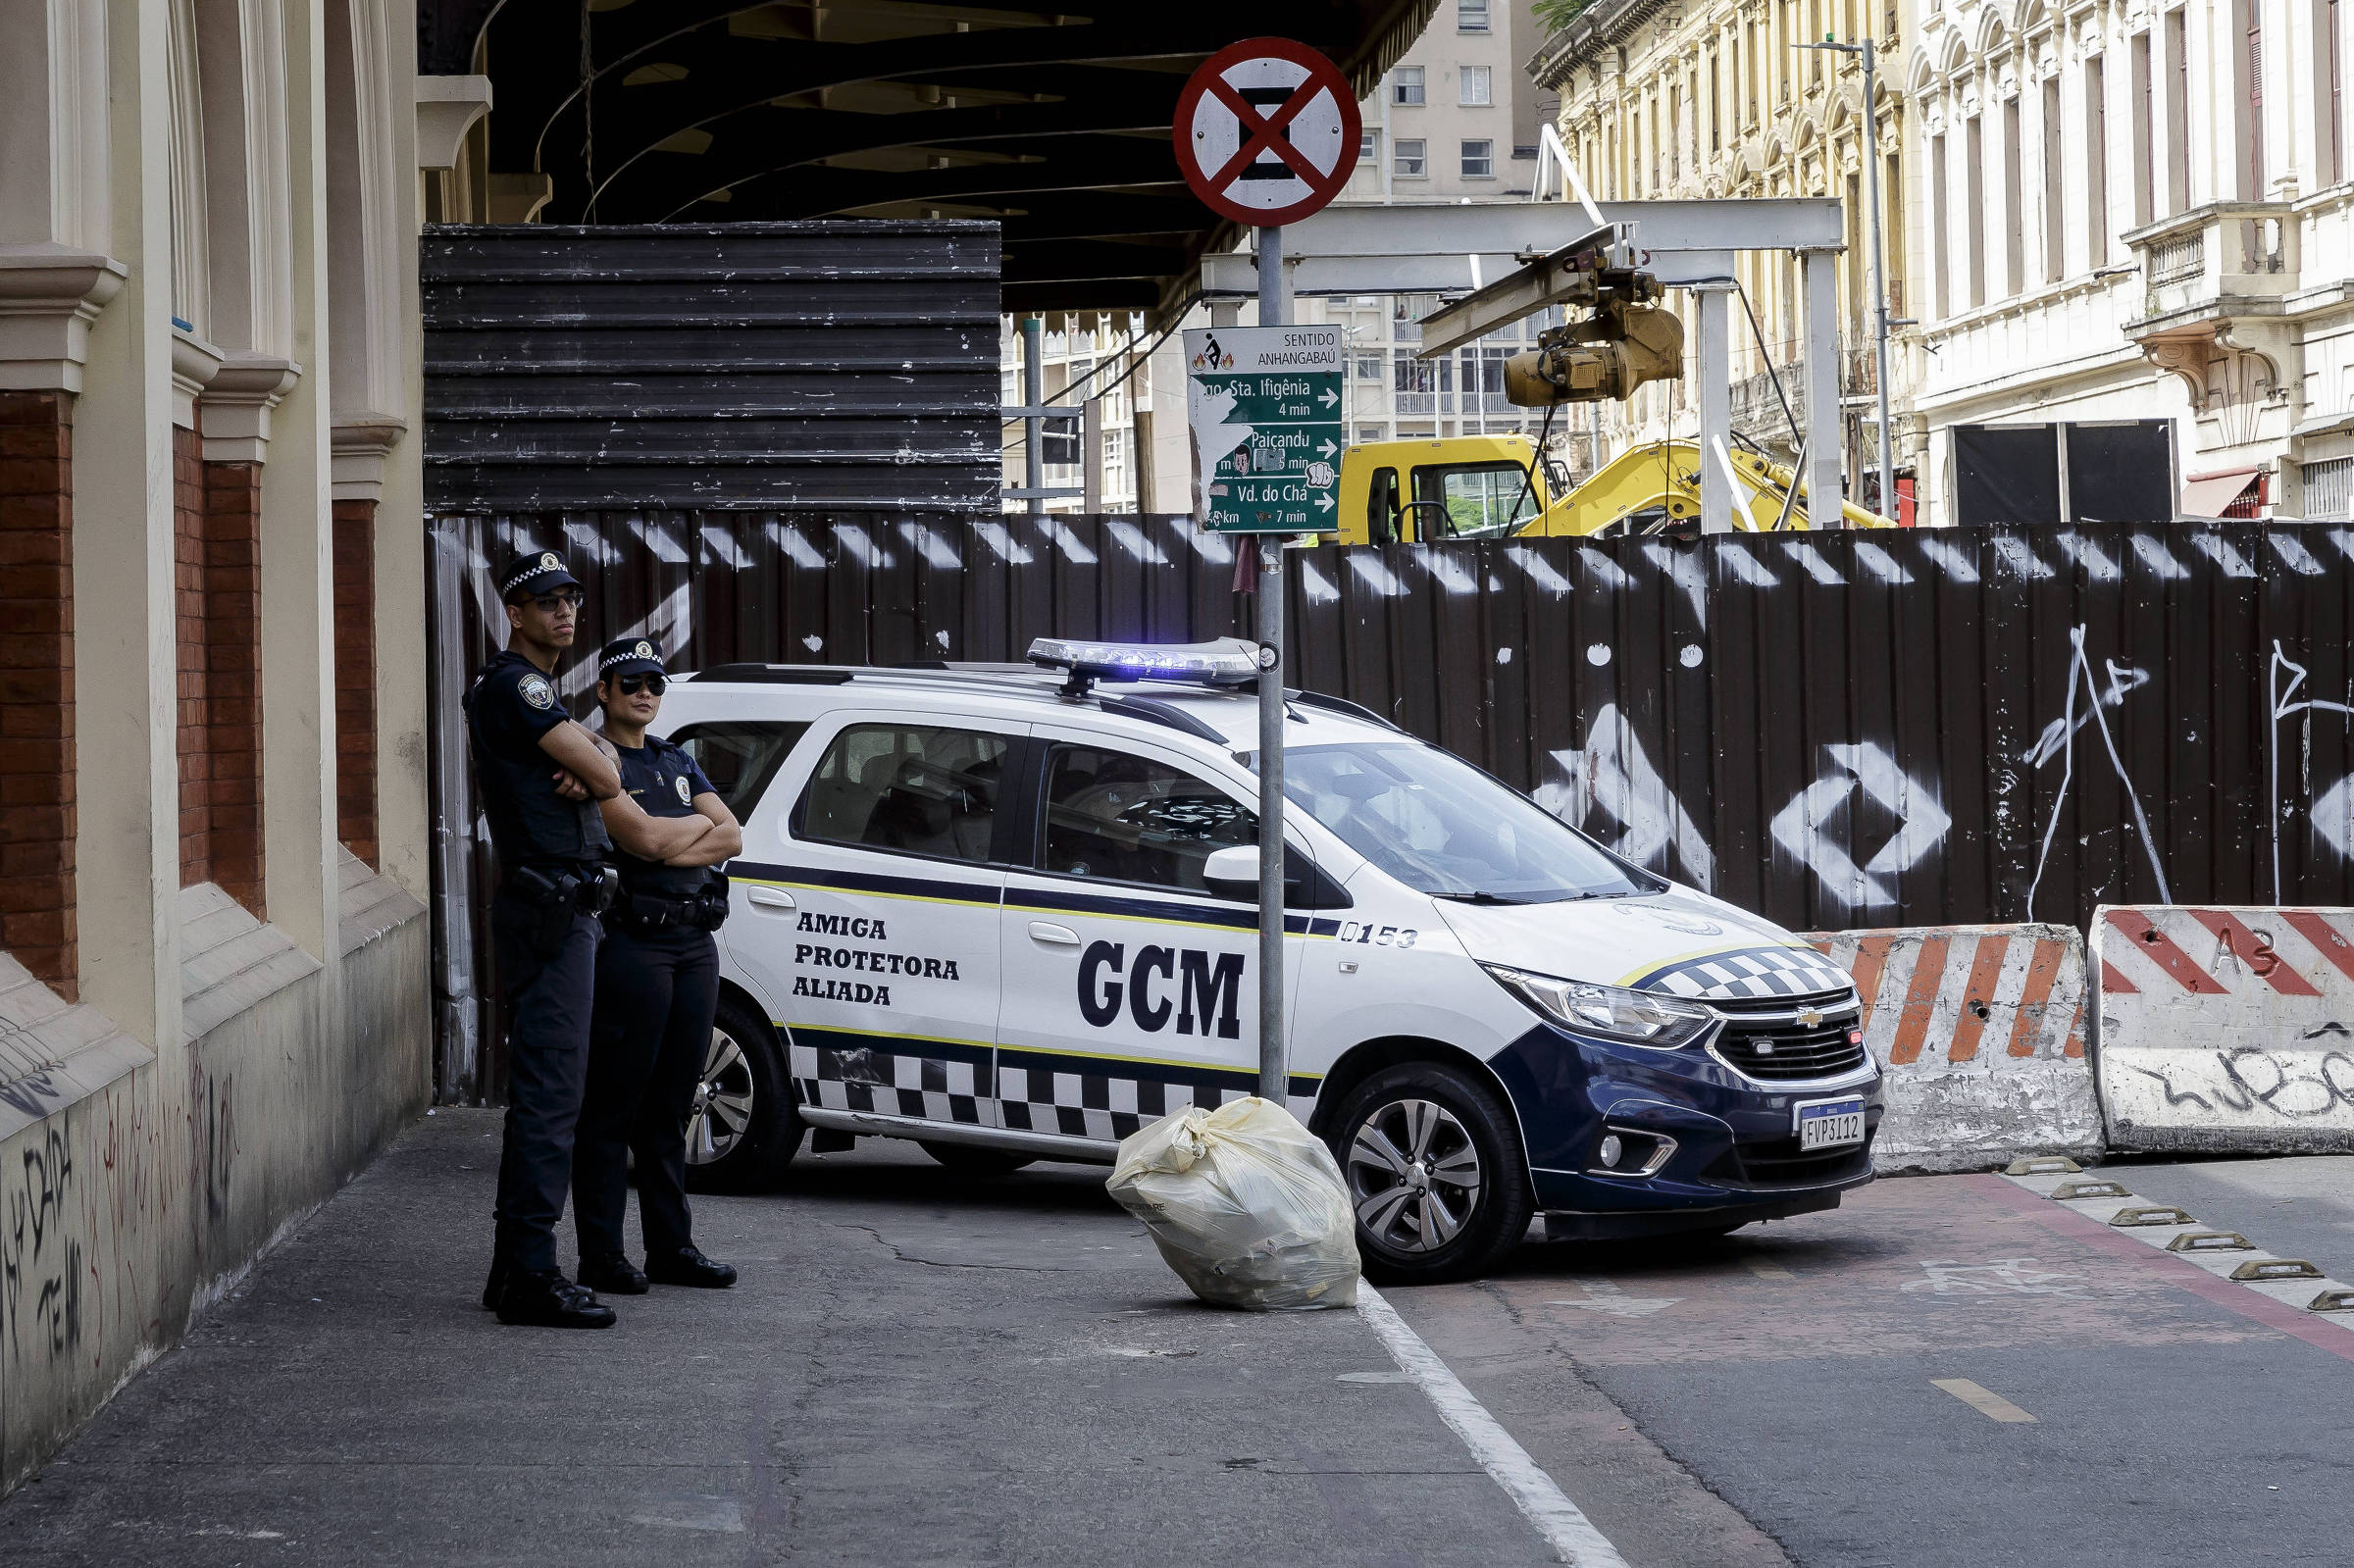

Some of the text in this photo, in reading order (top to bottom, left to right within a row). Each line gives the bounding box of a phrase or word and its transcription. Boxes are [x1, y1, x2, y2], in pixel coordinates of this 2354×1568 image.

[1284, 332, 1335, 347] SENTIDO
[1257, 348, 1336, 366] ANHANGABAÚ
[1230, 379, 1255, 396] Sta.
[1260, 378, 1310, 400] Ifigênia
[1278, 403, 1310, 416] 4 min
[1252, 430, 1309, 451] Paiçandu
[1288, 456, 1308, 469] min
[1237, 484, 1307, 502] Vd. do Chá
[1276, 510, 1283, 523] 7
[1286, 510, 1306, 523] min
[796, 911, 887, 941] AMIGA
[794, 942, 960, 982] PROTETORA
[792, 975, 892, 1007] ALIADA
[1077, 938, 1246, 1041] GCM
